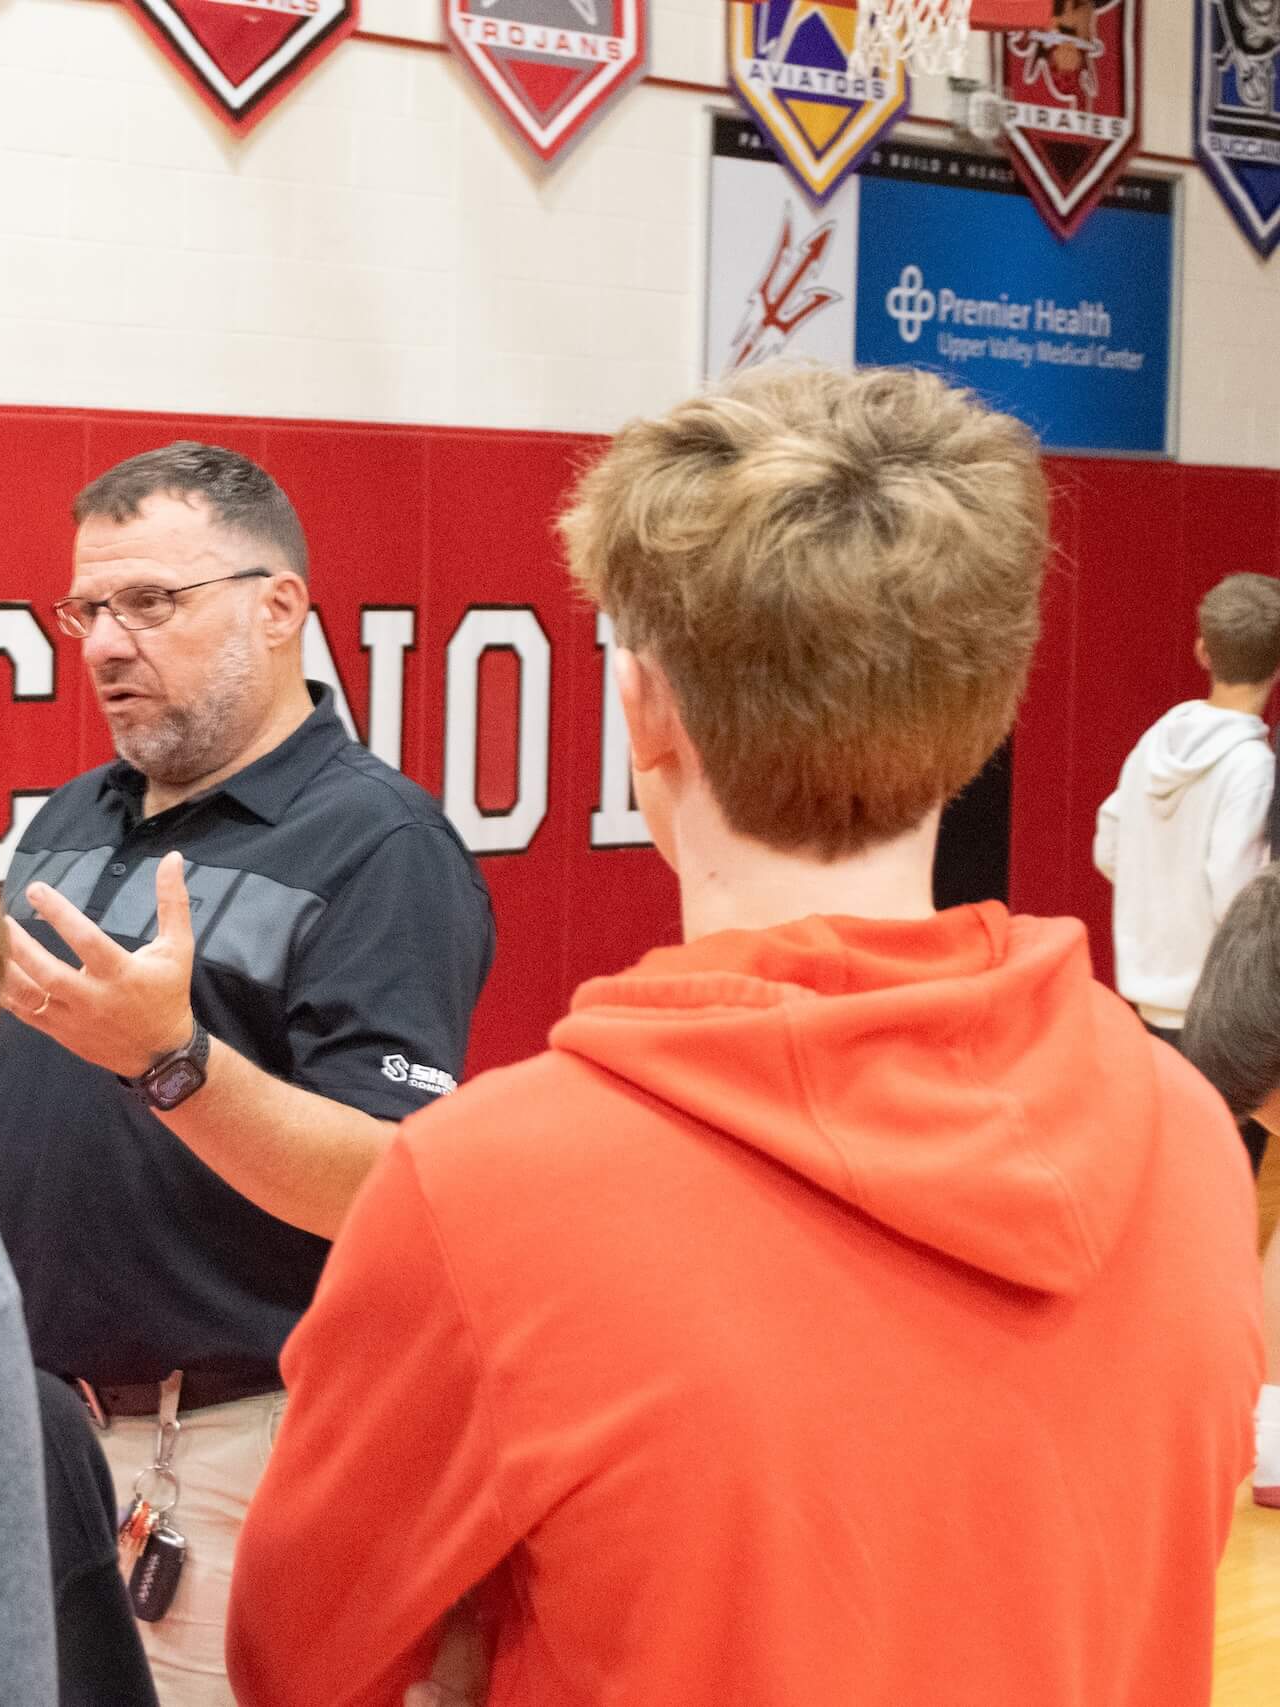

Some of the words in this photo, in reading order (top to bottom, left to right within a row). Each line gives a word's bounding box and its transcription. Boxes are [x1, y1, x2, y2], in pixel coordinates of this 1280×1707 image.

[461, 17, 621, 61] TROJANS
[749, 63, 885, 99] AVIATORS
[1007, 105, 1122, 139] PIRATES
[889, 152, 940, 173] BUILD
[938, 287, 1031, 331] Premier
[1034, 299, 1111, 337] Health
[937, 331, 987, 362] Upper
[988, 335, 1034, 368] Valley
[1036, 340, 1093, 366] Medical
[1096, 344, 1144, 370] Center
